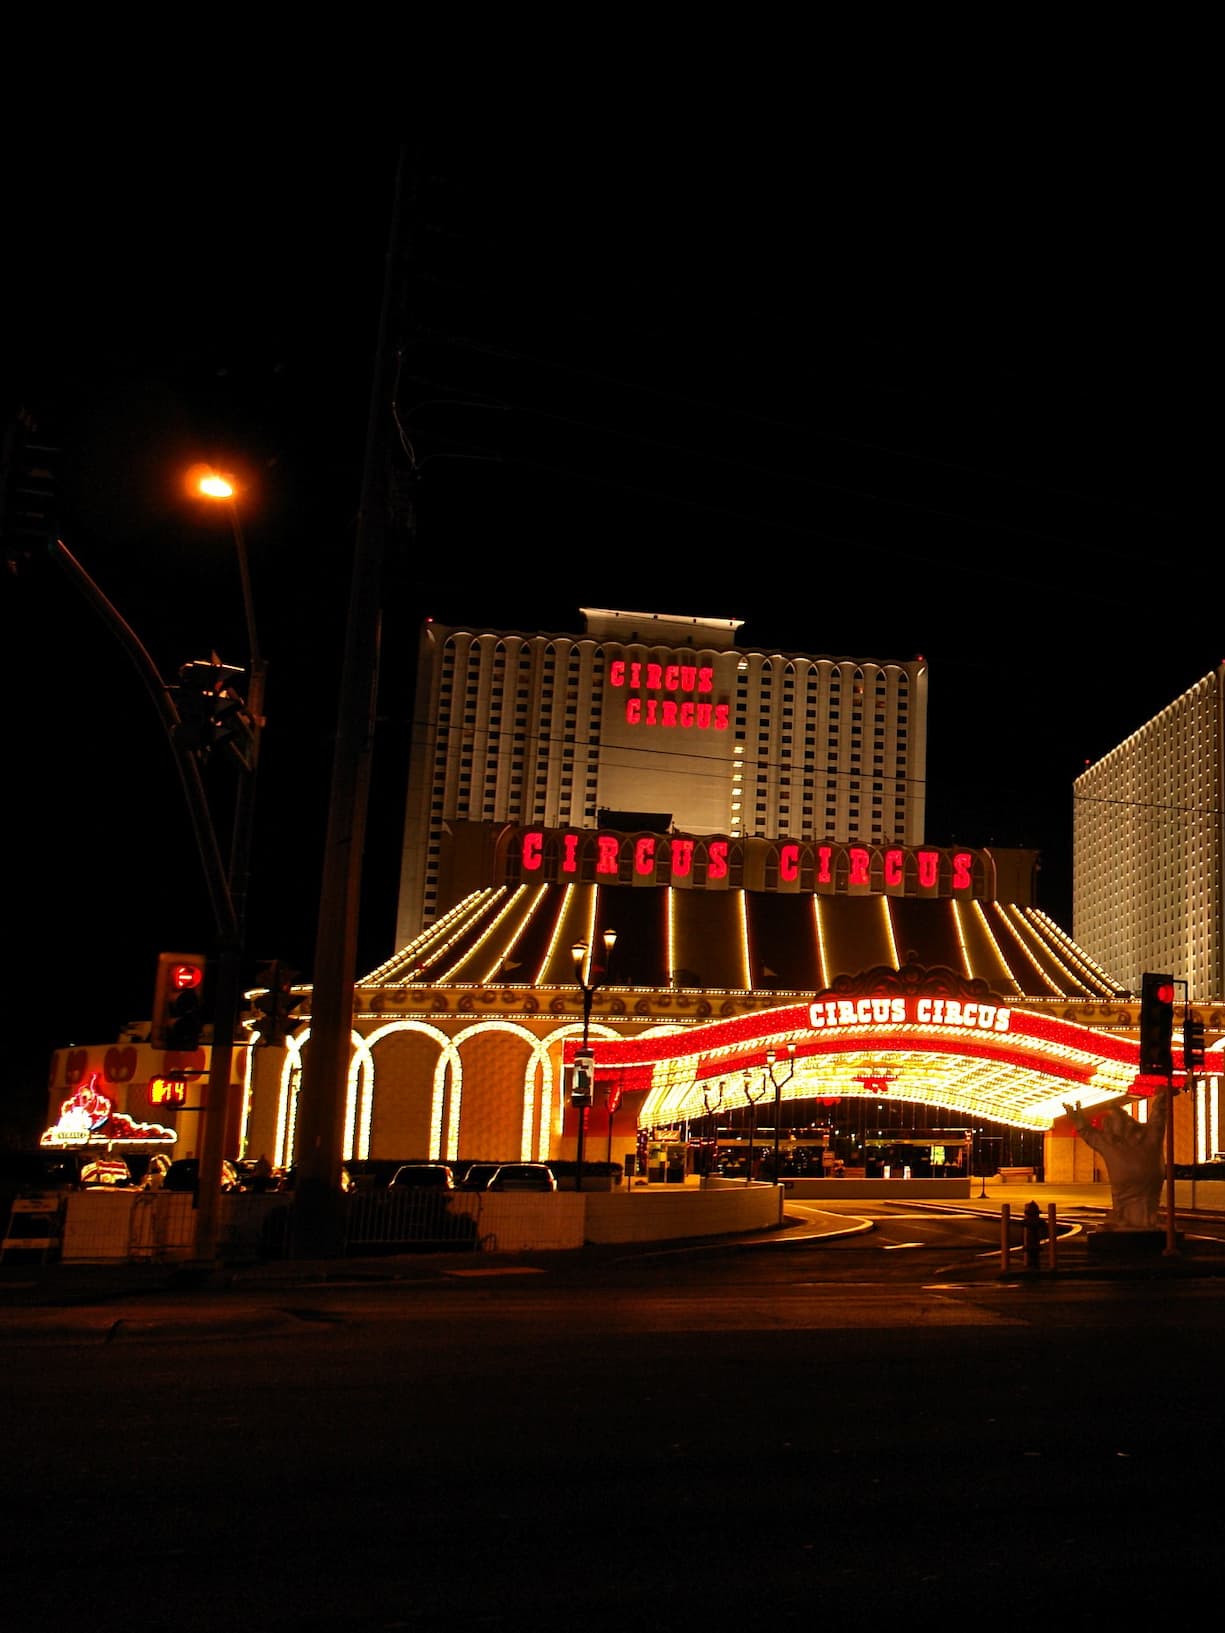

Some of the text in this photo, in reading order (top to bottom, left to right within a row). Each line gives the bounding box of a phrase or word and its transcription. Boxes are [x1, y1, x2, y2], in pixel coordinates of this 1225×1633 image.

[610, 661, 713, 692] CIRCUS
[626, 698, 729, 730] CIRCUS
[522, 832, 973, 890] CIRCUS CIRCUS
[809, 998, 1010, 1032] CIRCUS CIRCUS
